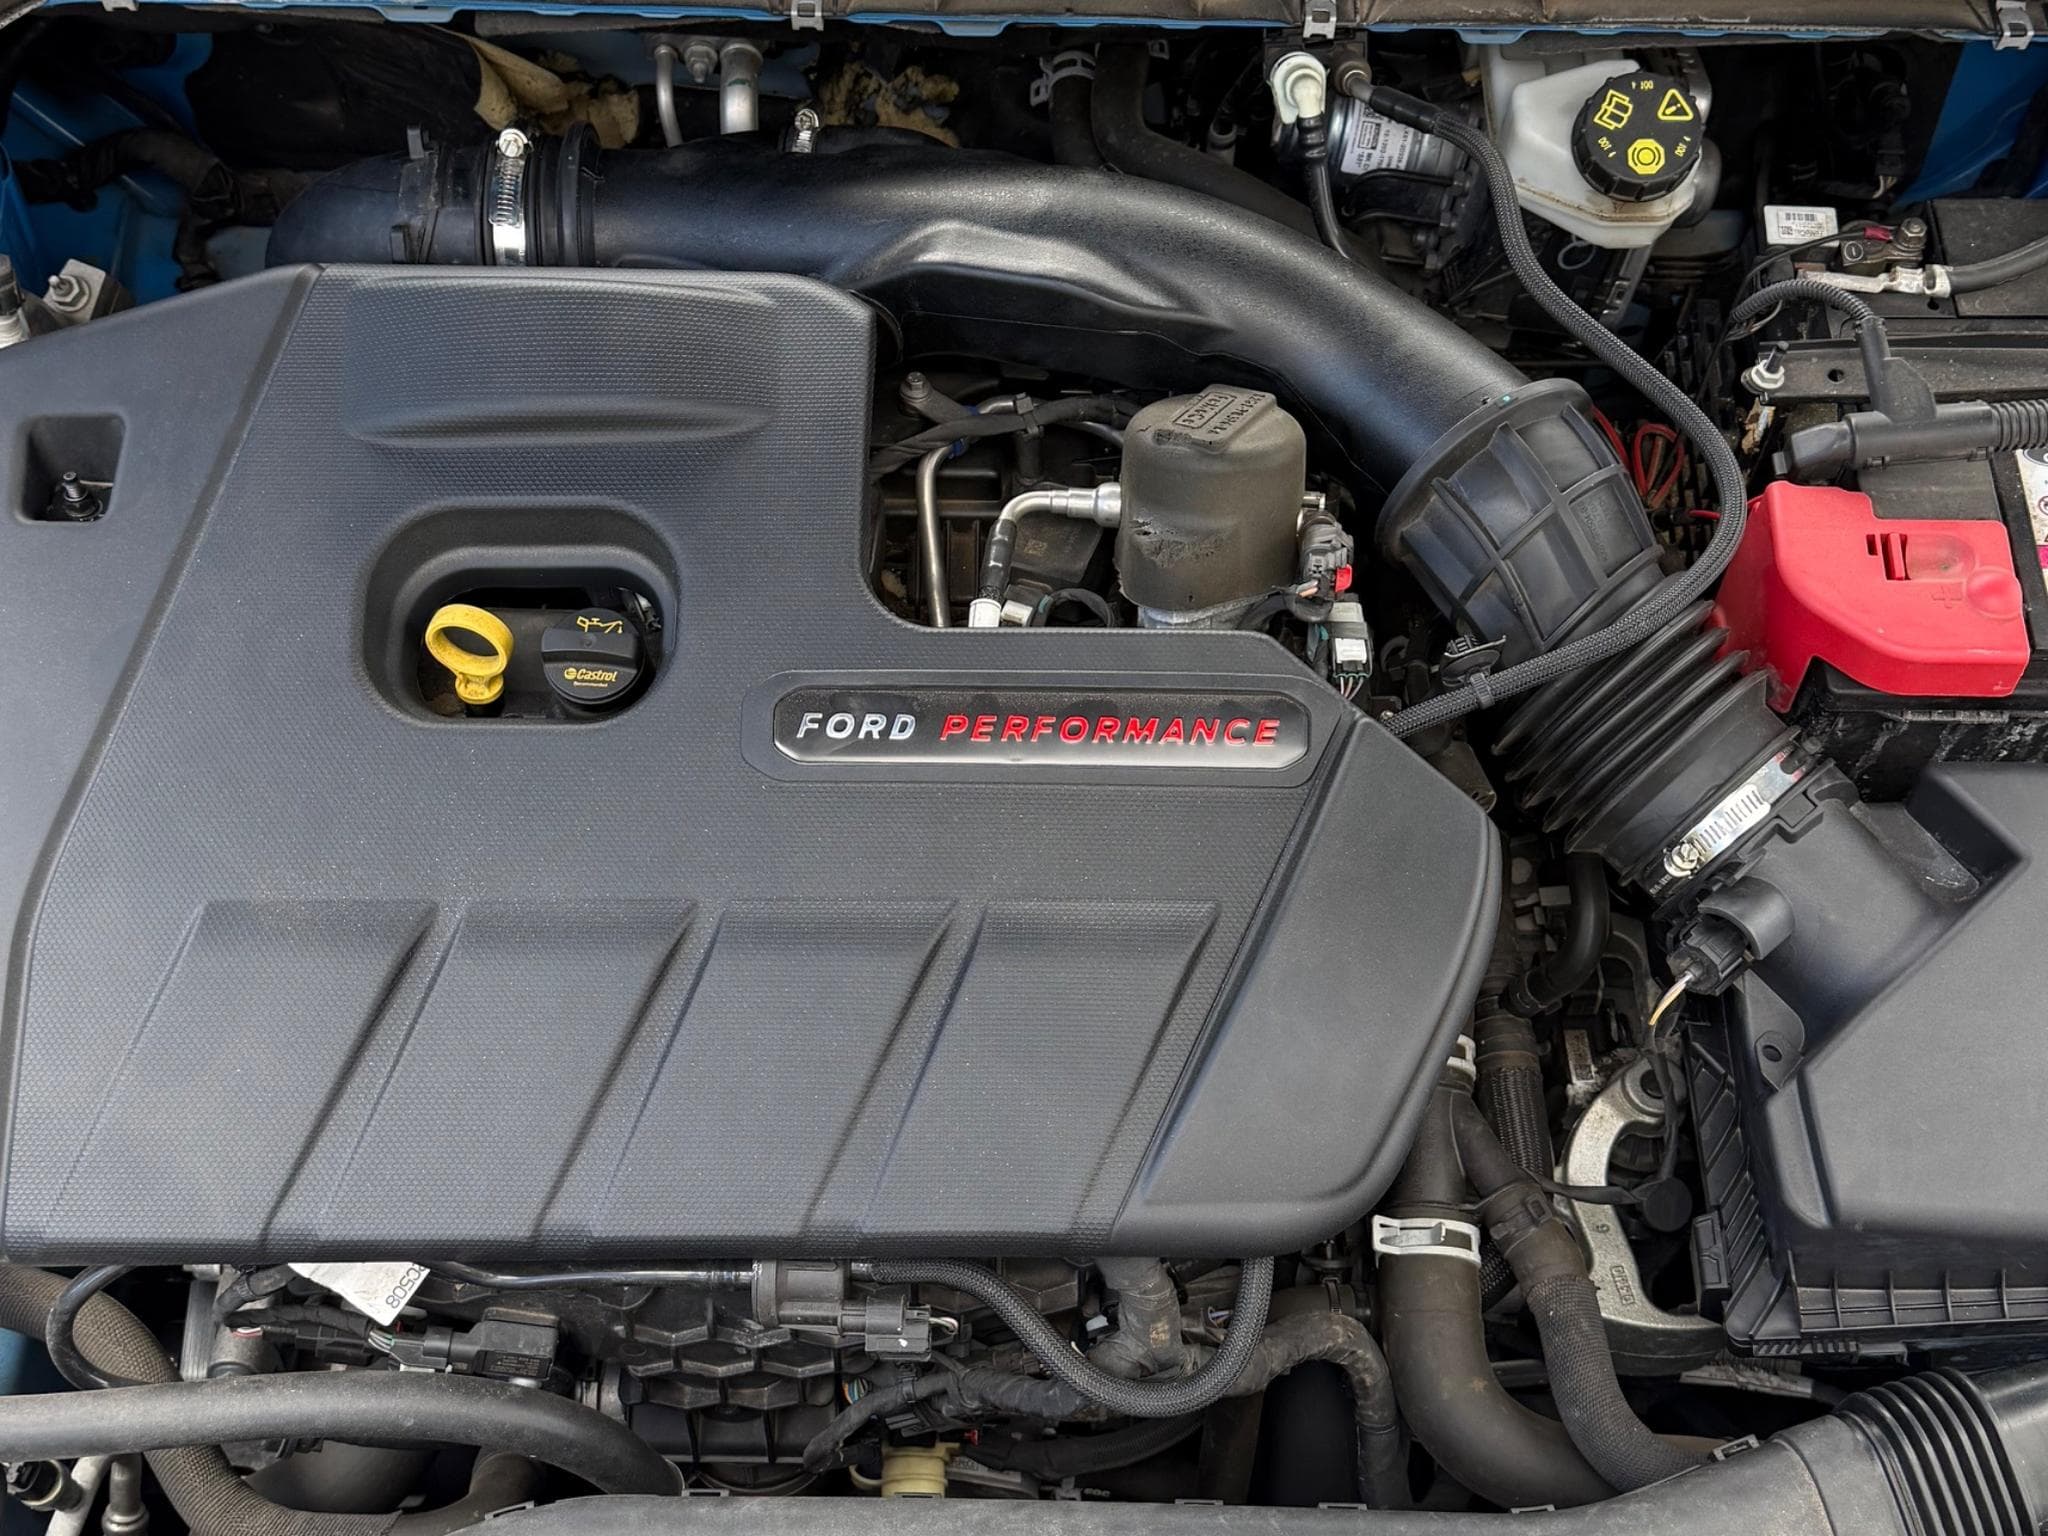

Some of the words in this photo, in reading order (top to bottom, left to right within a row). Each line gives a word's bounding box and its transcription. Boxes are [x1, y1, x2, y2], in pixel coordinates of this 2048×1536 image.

[577, 668, 619, 682] Castrol
[796, 712, 917, 740] FORD
[940, 713, 1281, 747] PERFORMANCE
